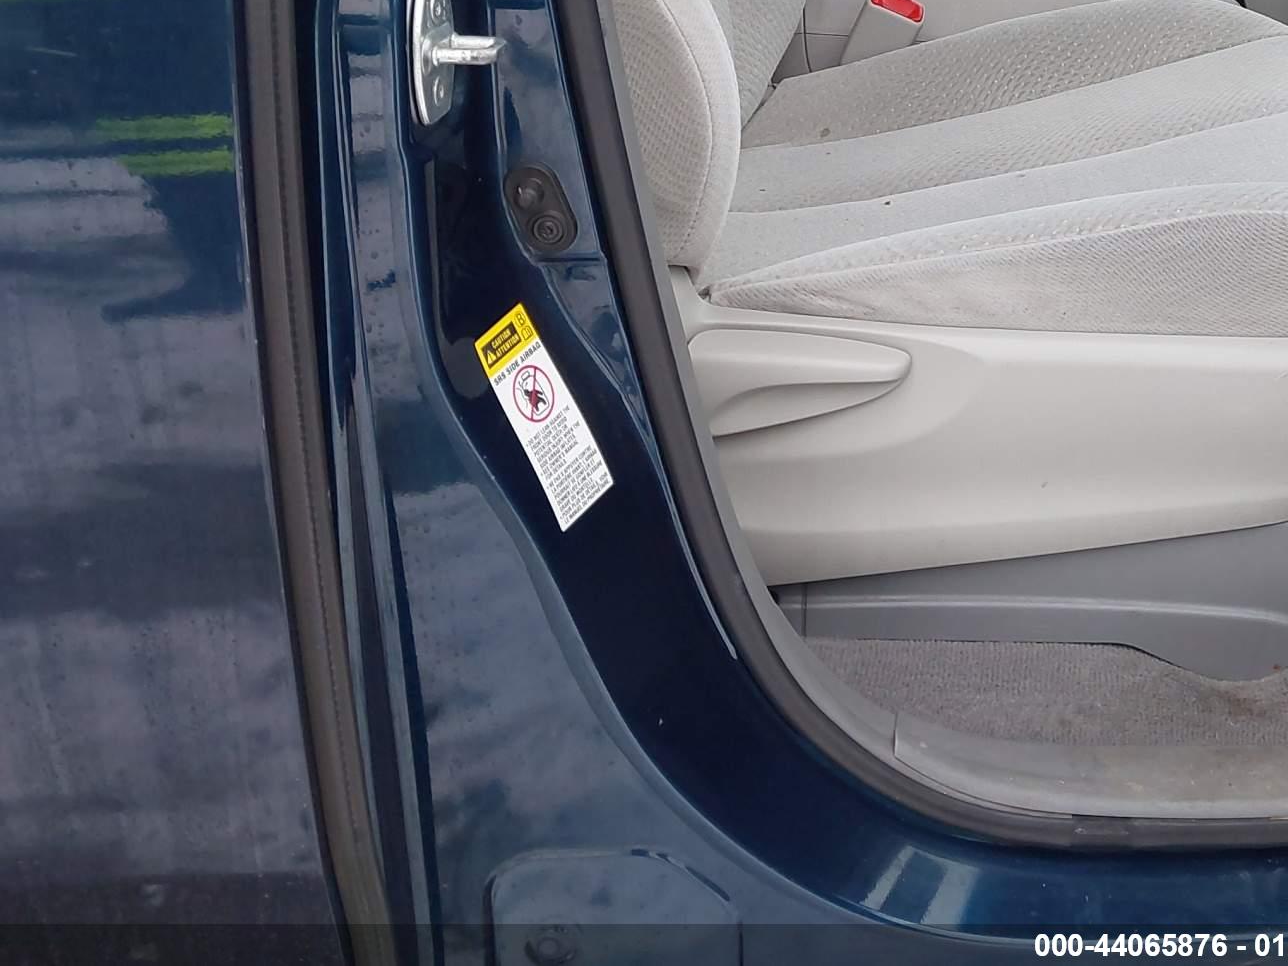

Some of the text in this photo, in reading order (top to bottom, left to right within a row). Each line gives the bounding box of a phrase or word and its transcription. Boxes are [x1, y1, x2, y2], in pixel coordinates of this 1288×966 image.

[491, 328, 511, 348] CAUTION
[495, 333, 519, 357] ATTENTION
[493, 341, 540, 385] SRS SIDE AIRBAG
